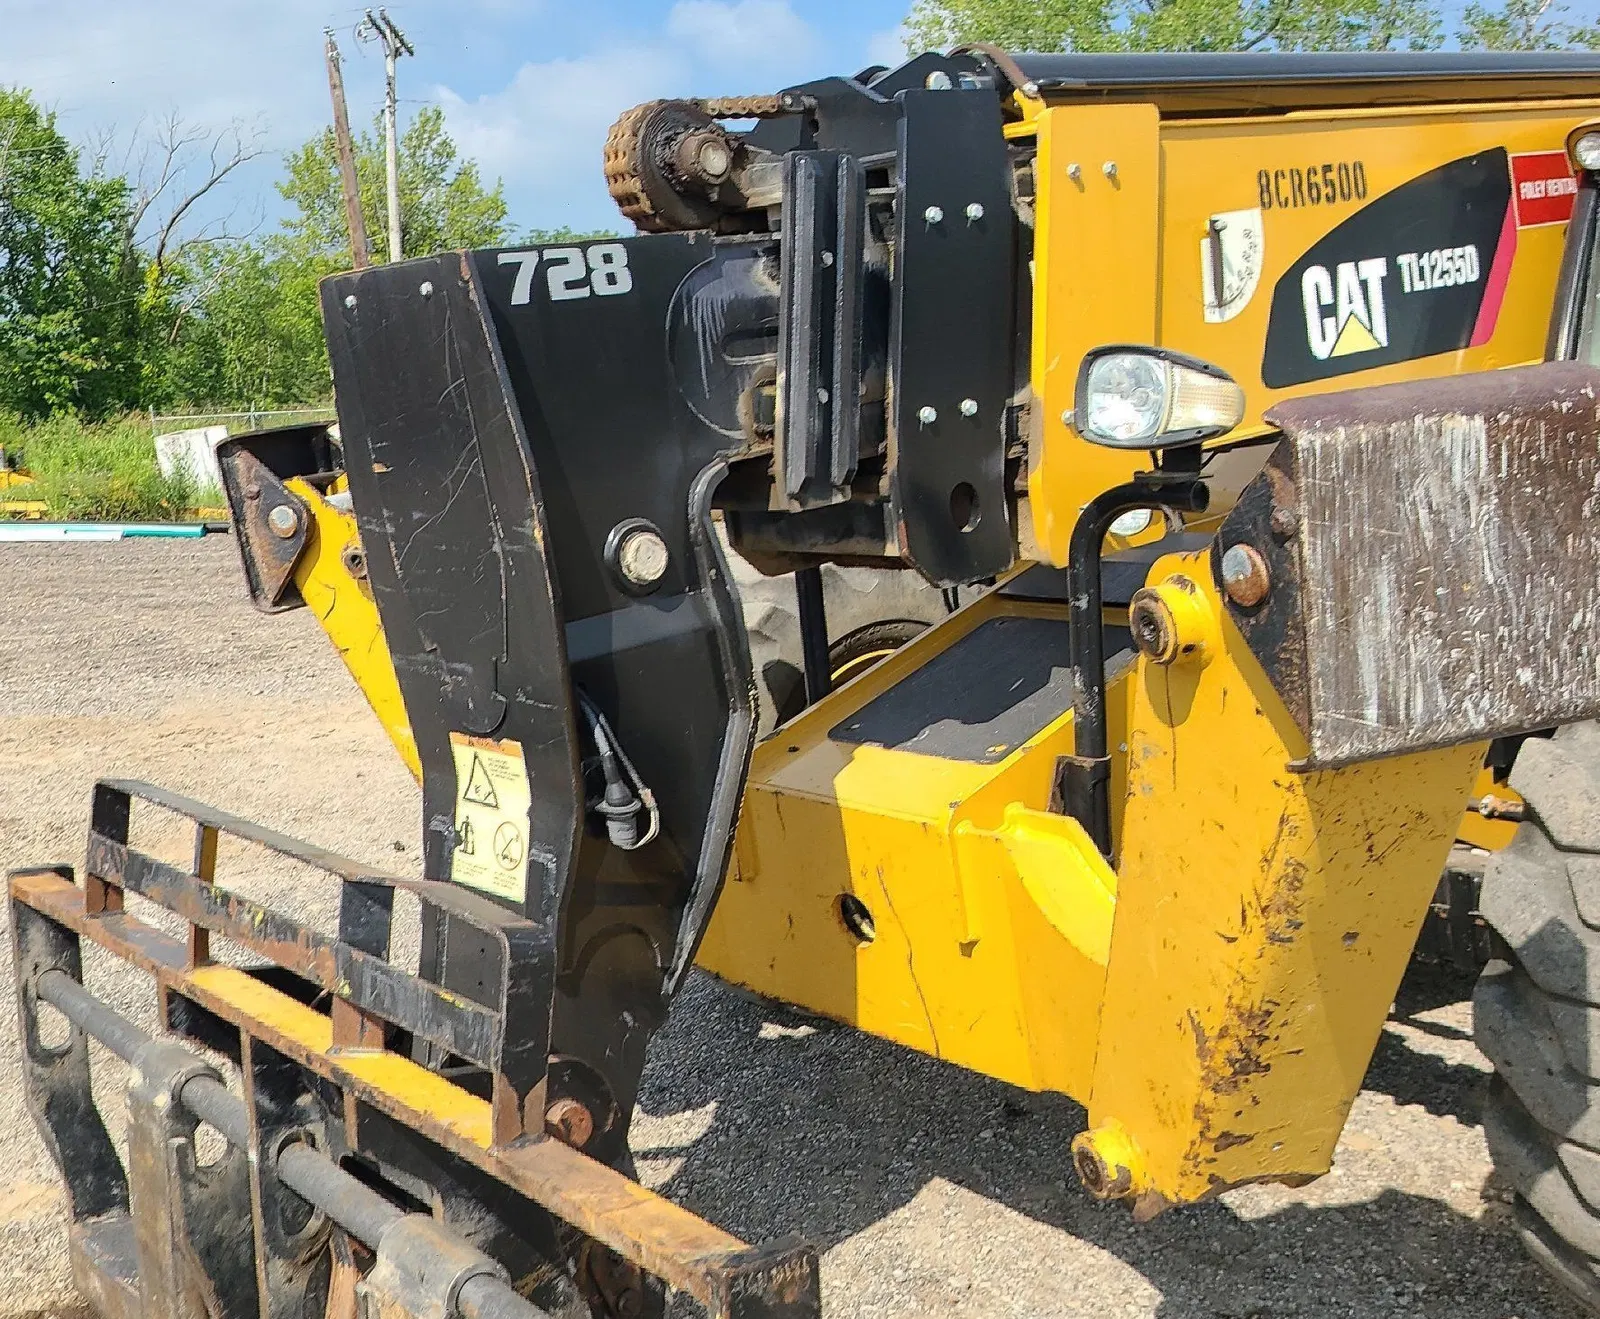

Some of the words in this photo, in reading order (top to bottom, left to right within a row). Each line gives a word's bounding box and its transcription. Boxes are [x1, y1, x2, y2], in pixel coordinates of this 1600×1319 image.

[1257, 161, 1367, 210] 8CR6500
[497, 243, 633, 306] 728
[1302, 257, 1389, 361] CAT
[1396, 244, 1481, 294] TL1255D
